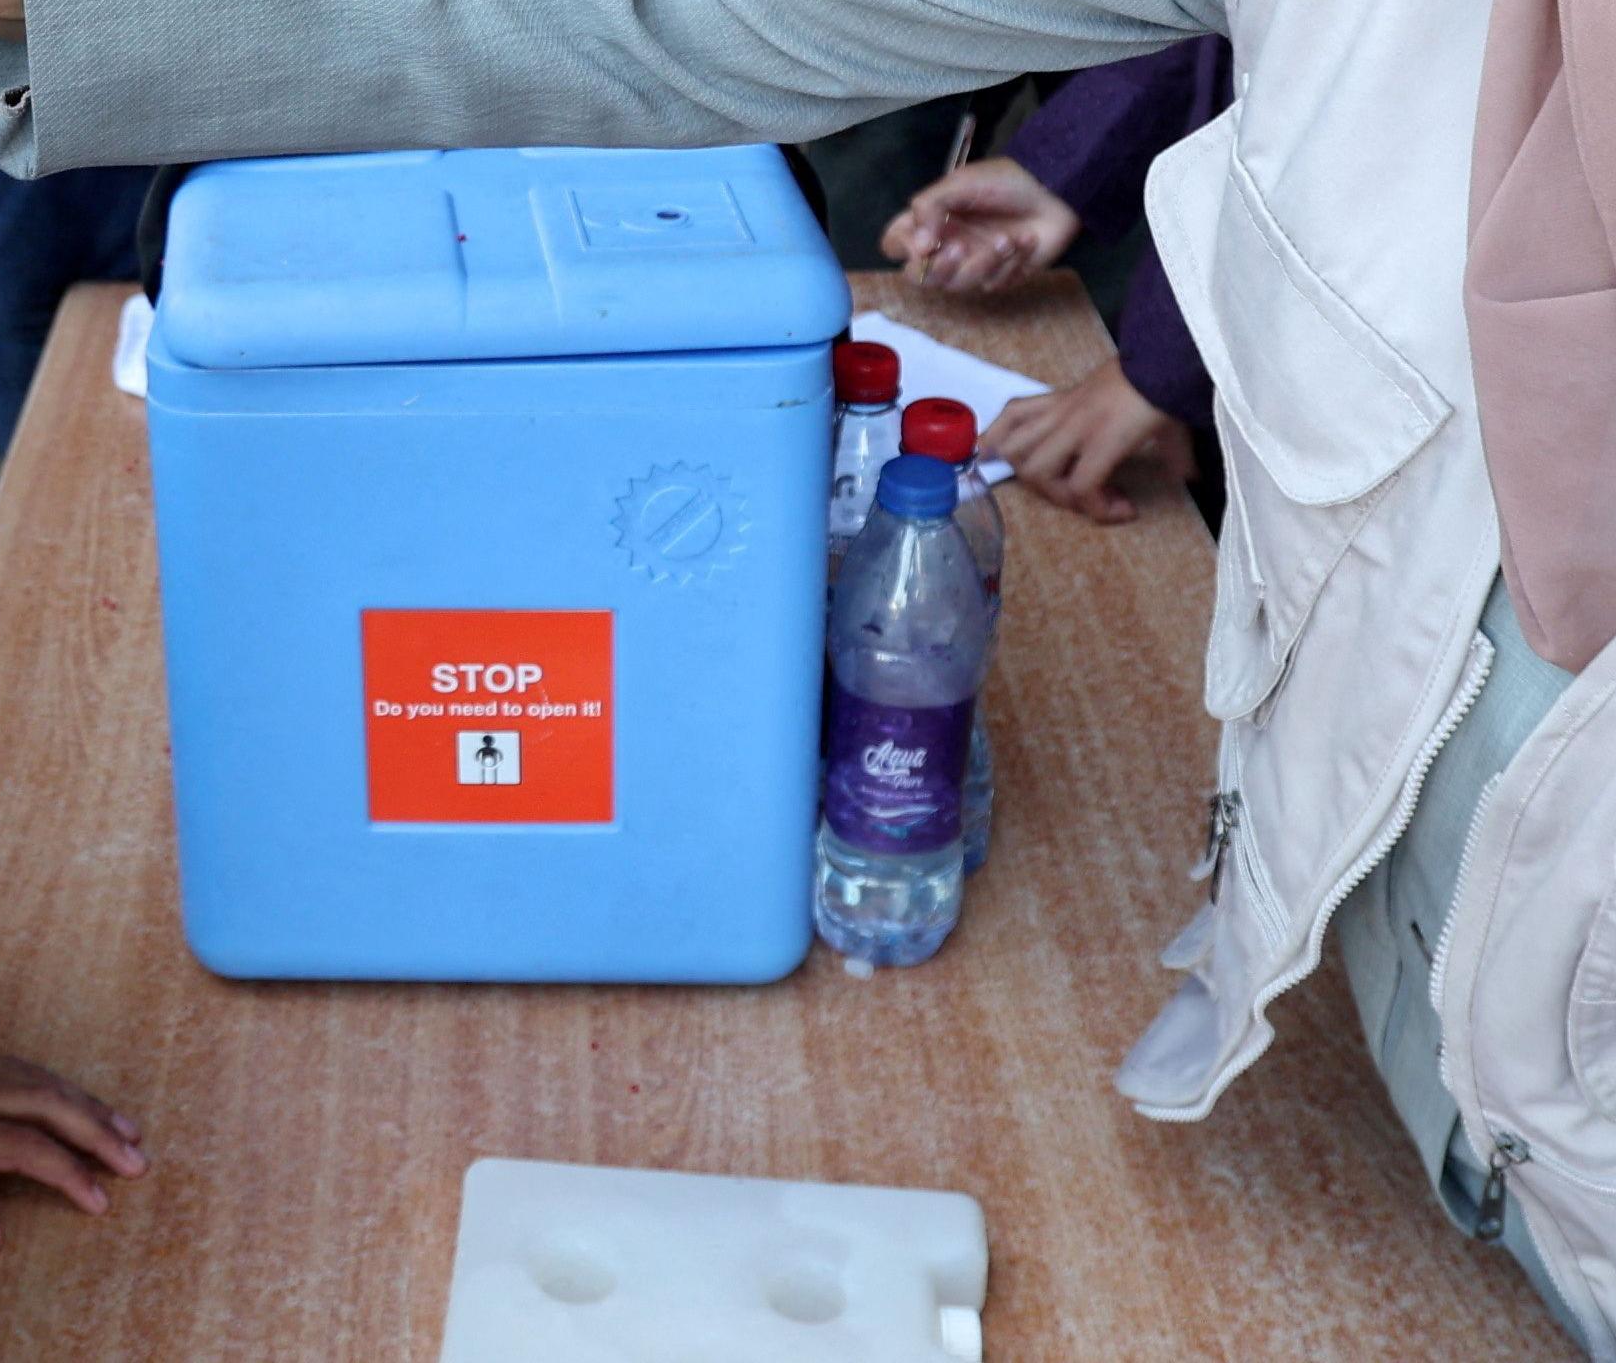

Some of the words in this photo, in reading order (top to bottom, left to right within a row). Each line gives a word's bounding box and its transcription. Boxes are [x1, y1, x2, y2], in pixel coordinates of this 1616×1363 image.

[431, 663, 543, 693] STOP
[374, 700, 402, 716] Do
[407, 702, 444, 719] you
[449, 701, 498, 716] need
[502, 701, 522, 716] to
[527, 702, 577, 719] open
[864, 740, 927, 776] Aqua
